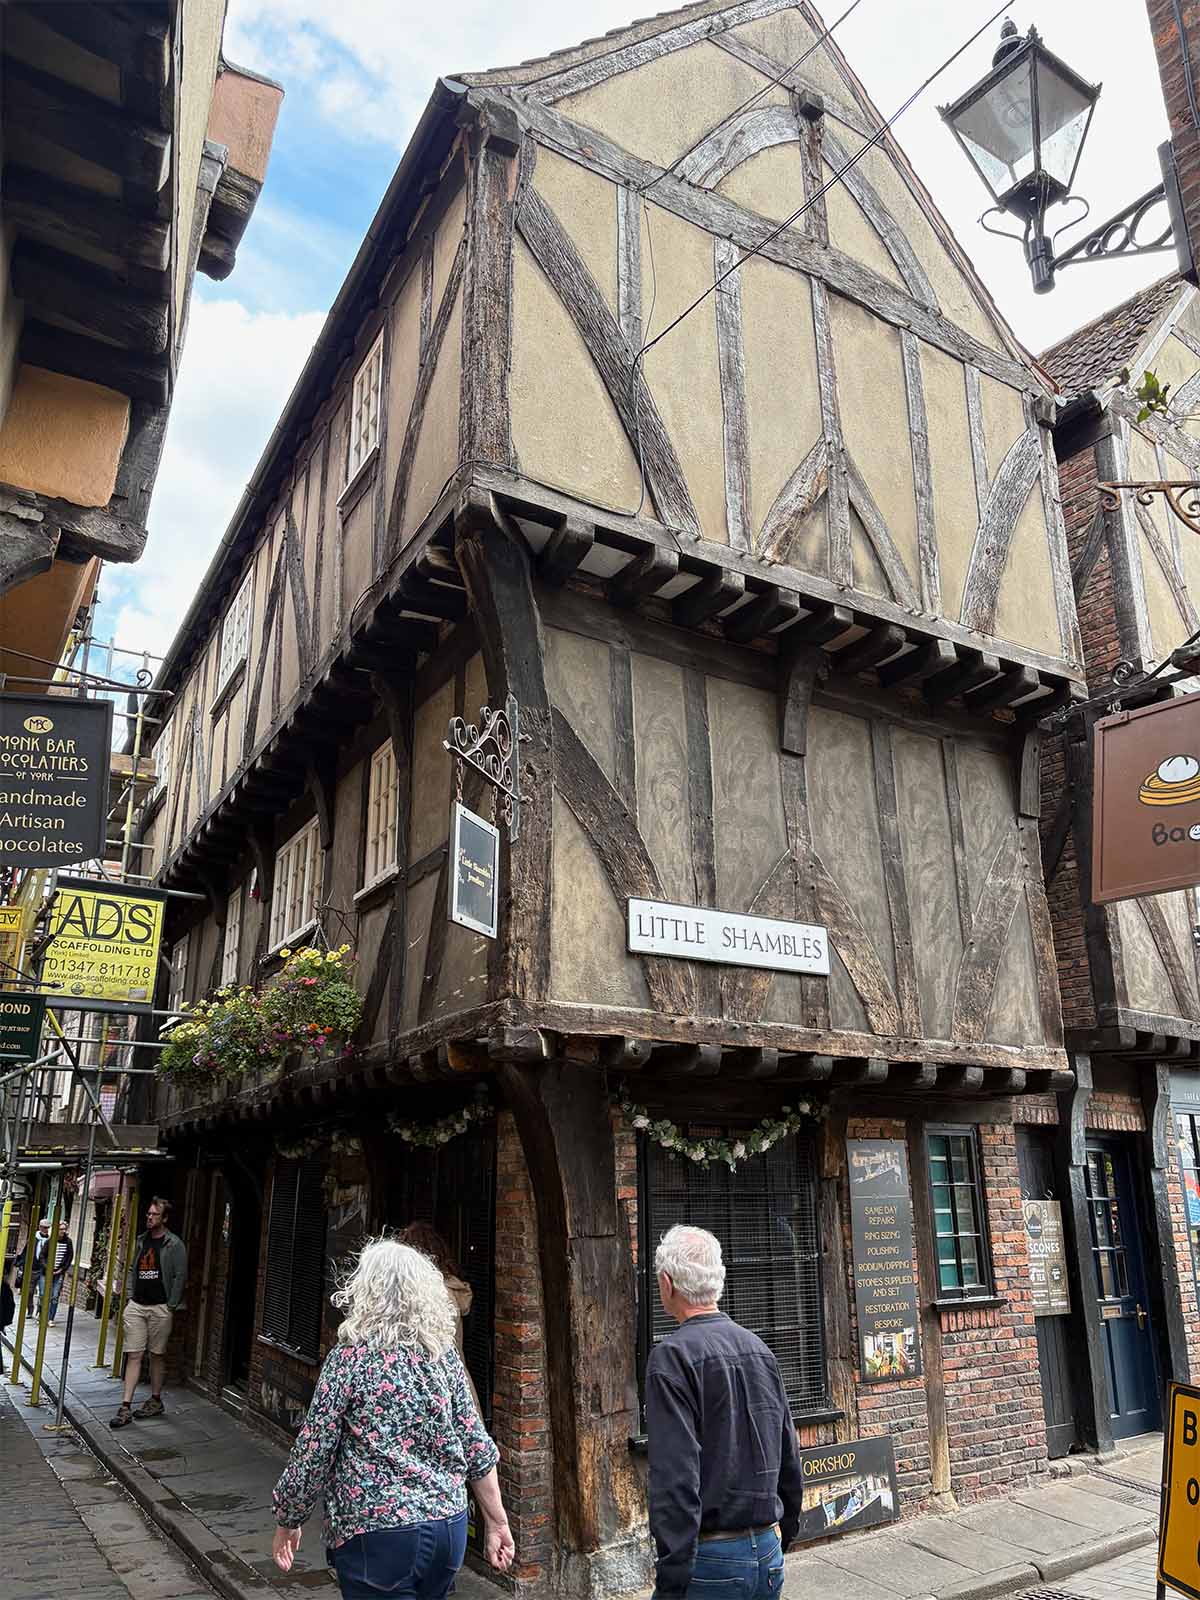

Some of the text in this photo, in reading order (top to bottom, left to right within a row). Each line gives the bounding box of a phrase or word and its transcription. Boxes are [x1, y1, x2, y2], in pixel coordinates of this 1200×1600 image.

[46, 738, 76, 754] BAR
[30, 771, 54, 781] YORK
[0, 812, 65, 830] Artisan
[55, 896, 153, 944] ADS
[637, 914, 823, 961] LITTLE SHAMBLES
[51, 939, 153, 958] SCAFFOLDING LTD
[49, 957, 151, 979] 01347 811718
[884, 1204, 897, 1215] DAY
[868, 1216, 896, 1225] REPAIRS
[864, 1231, 881, 1241] RING
[867, 1245, 900, 1256] POLISHING
[1029, 1242, 1061, 1253] SCONES
[857, 1275, 913, 1288] STONES SUPPLIED
[872, 1286, 901, 1297] AND SET
[865, 1301, 910, 1314] RESTORATION
[874, 1318, 904, 1329] BESPOKE
[800, 1452, 856, 1477] ORKSHOP
